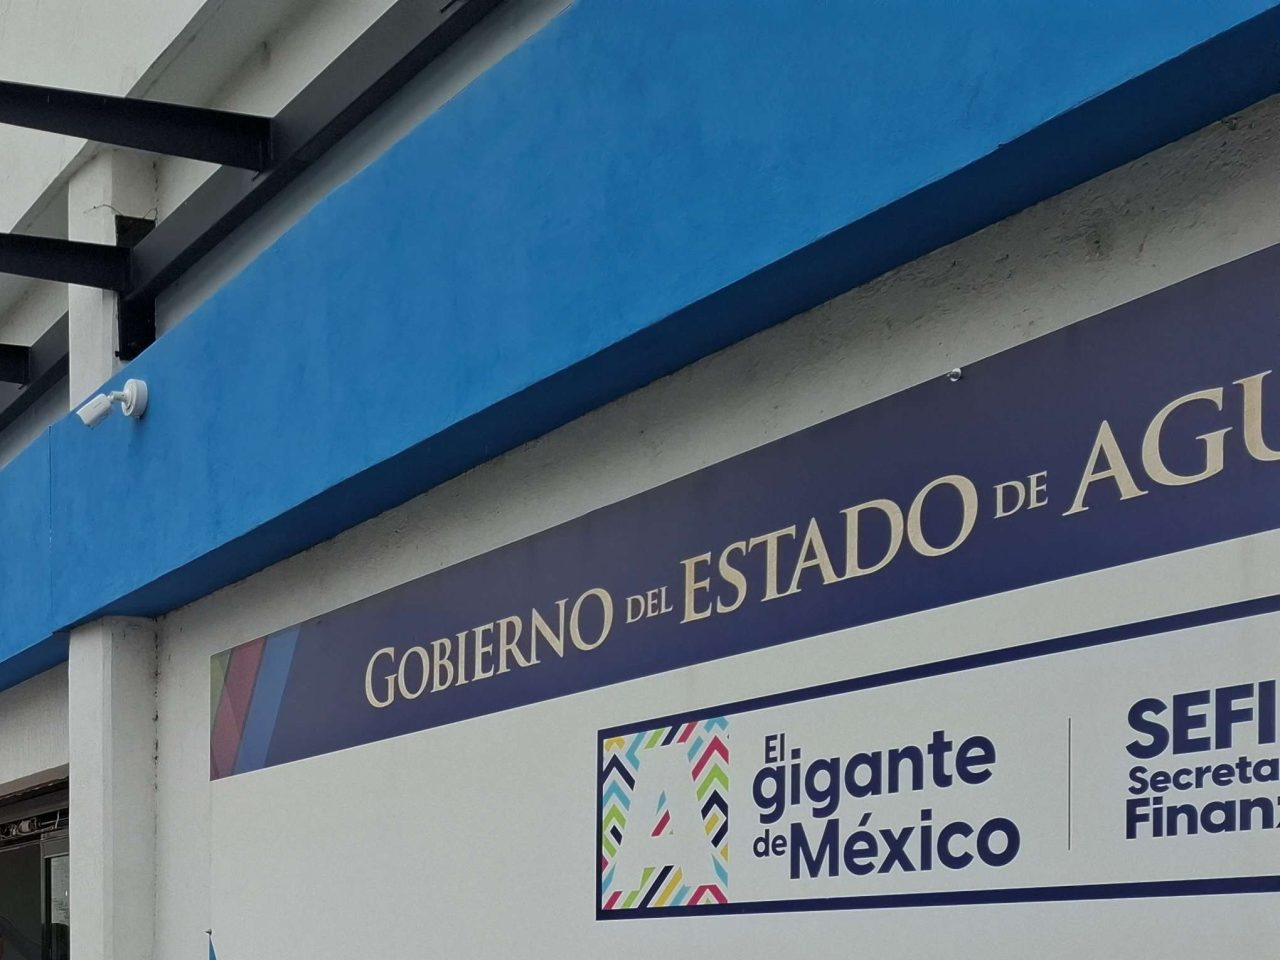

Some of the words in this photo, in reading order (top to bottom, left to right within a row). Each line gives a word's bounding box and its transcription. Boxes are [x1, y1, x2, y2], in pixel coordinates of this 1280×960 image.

[365, 587, 614, 708] GOBIERNO
[626, 586, 673, 623] DEL
[680, 474, 979, 624] ESTADO
[993, 470, 1049, 519] DE
[765, 732, 785, 764] El
[1125, 679, 1276, 760] SEFI
[752, 729, 996, 825] gigante
[1128, 756, 1280, 795] Secreta
[753, 829, 787, 858] de
[790, 808, 1021, 880] México
[1125, 795, 1280, 840] Finan
